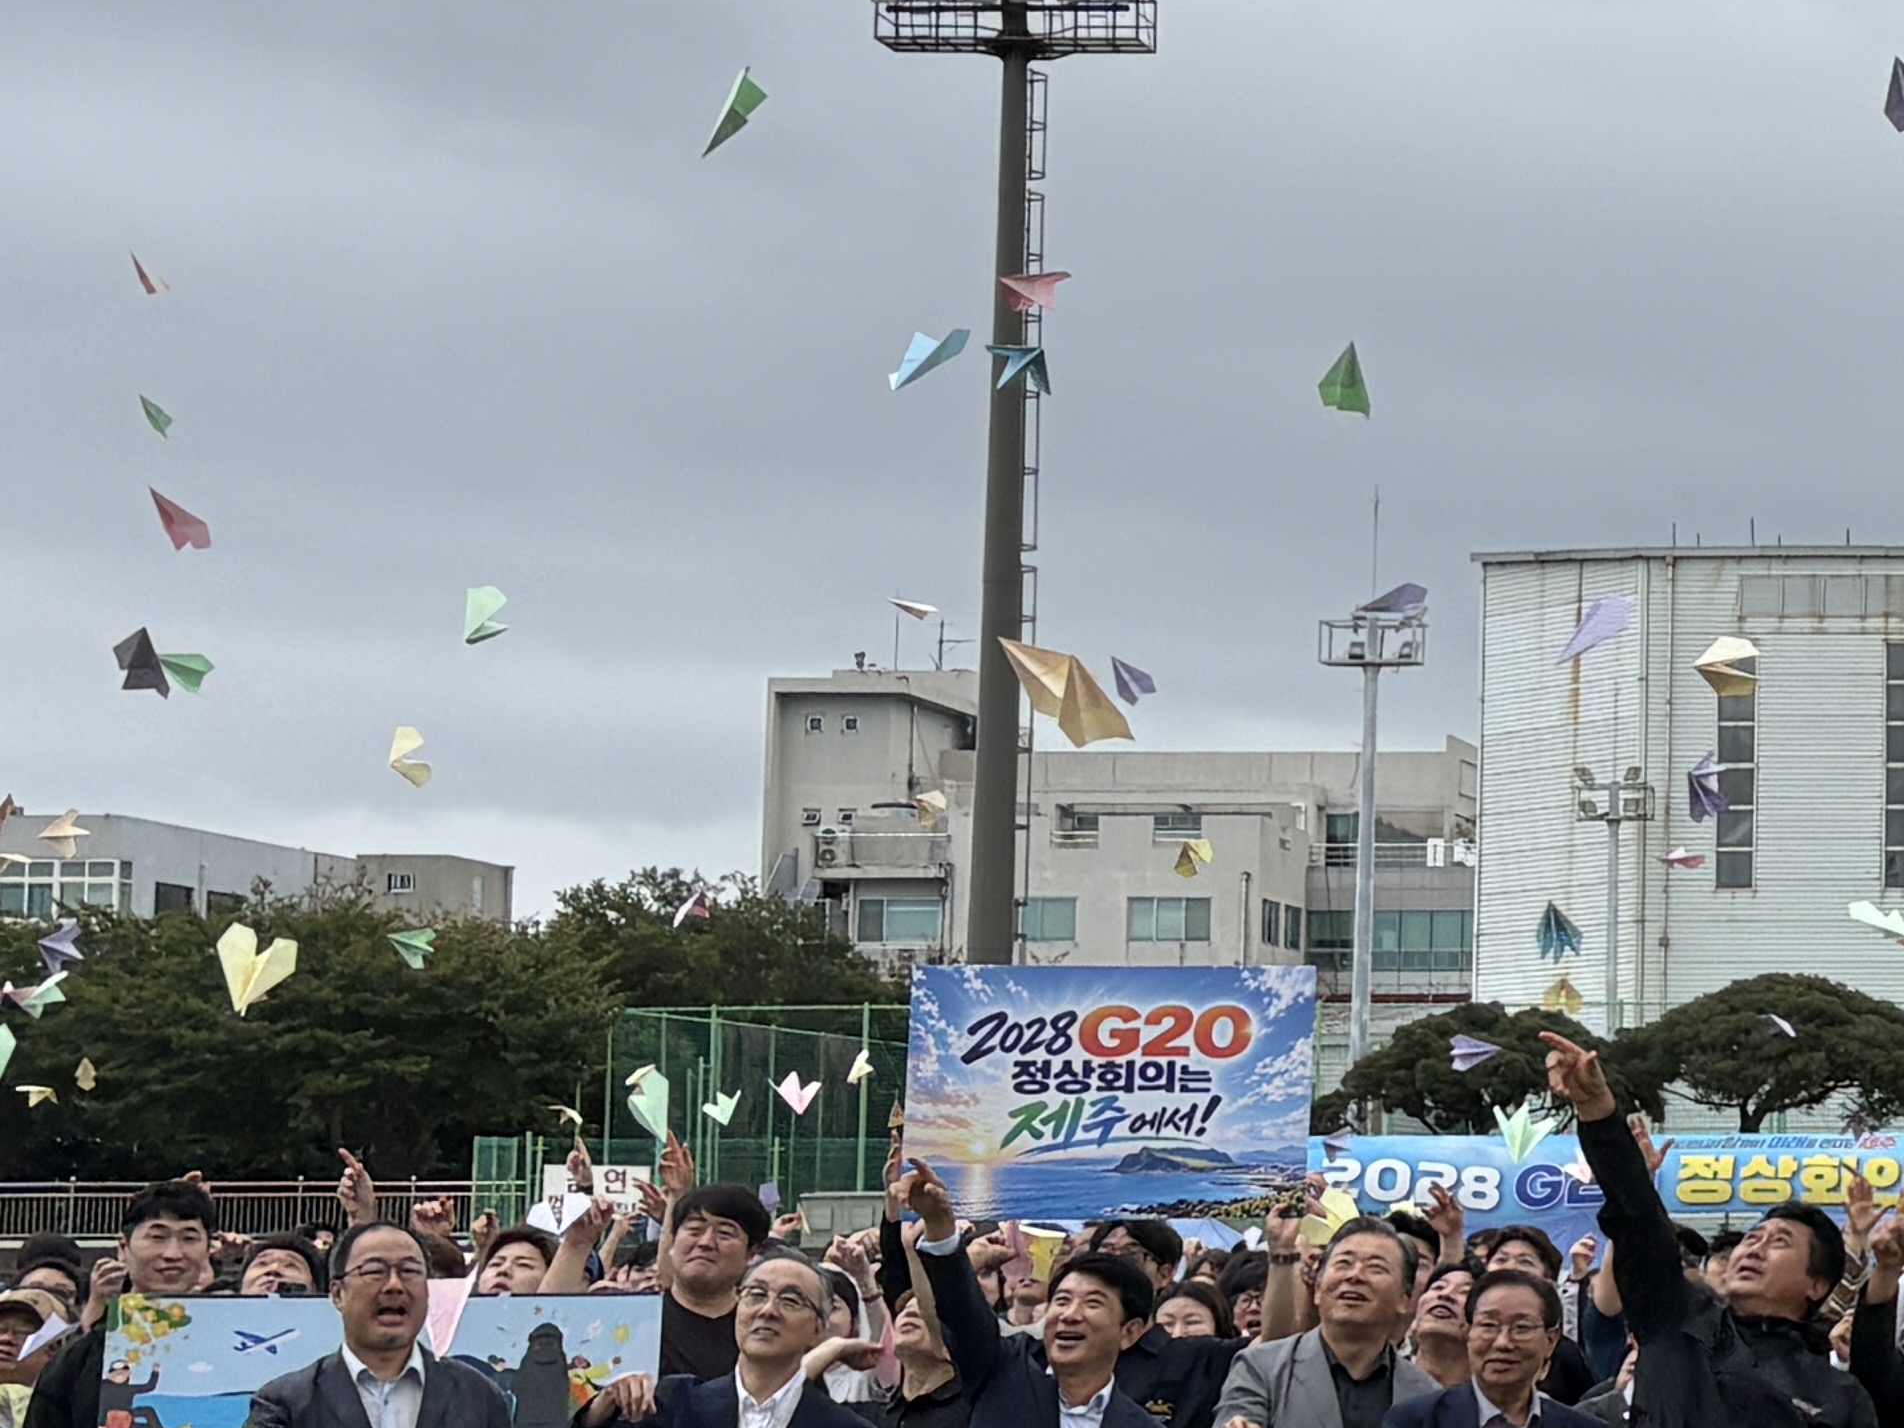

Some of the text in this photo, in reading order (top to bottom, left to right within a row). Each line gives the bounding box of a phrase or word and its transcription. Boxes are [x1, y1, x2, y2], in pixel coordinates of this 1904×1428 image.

[960, 1004, 1253, 1065] 2028 G20
[1011, 1059, 1213, 1096] 정상회의는
